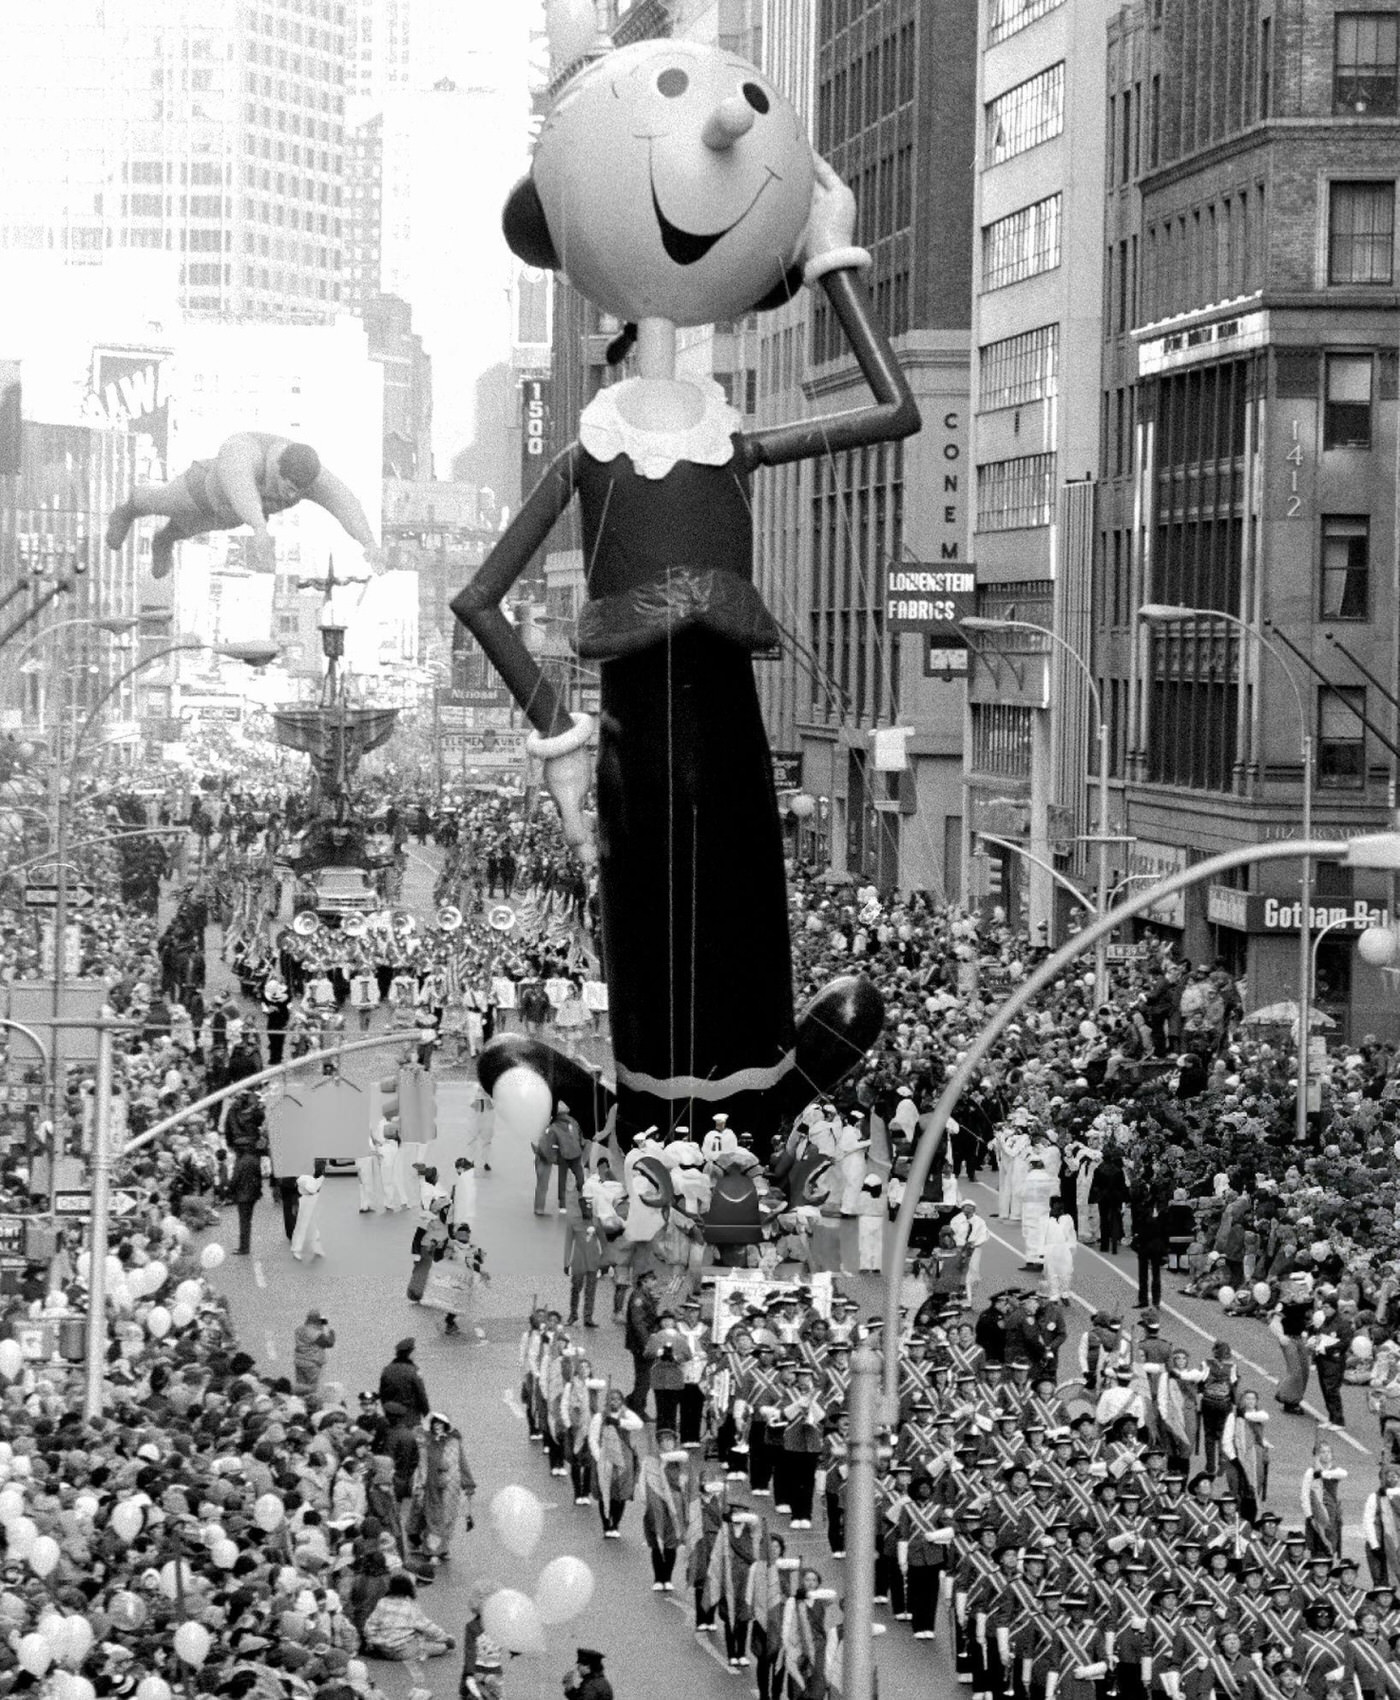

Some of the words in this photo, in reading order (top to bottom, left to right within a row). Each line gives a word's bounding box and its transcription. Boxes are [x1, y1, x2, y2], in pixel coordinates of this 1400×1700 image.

[528, 382, 543, 454] 1500
[1286, 420, 1304, 517] 1412
[889, 572, 974, 592] LOWENSTEIN
[888, 600, 955, 620] FABRICS
